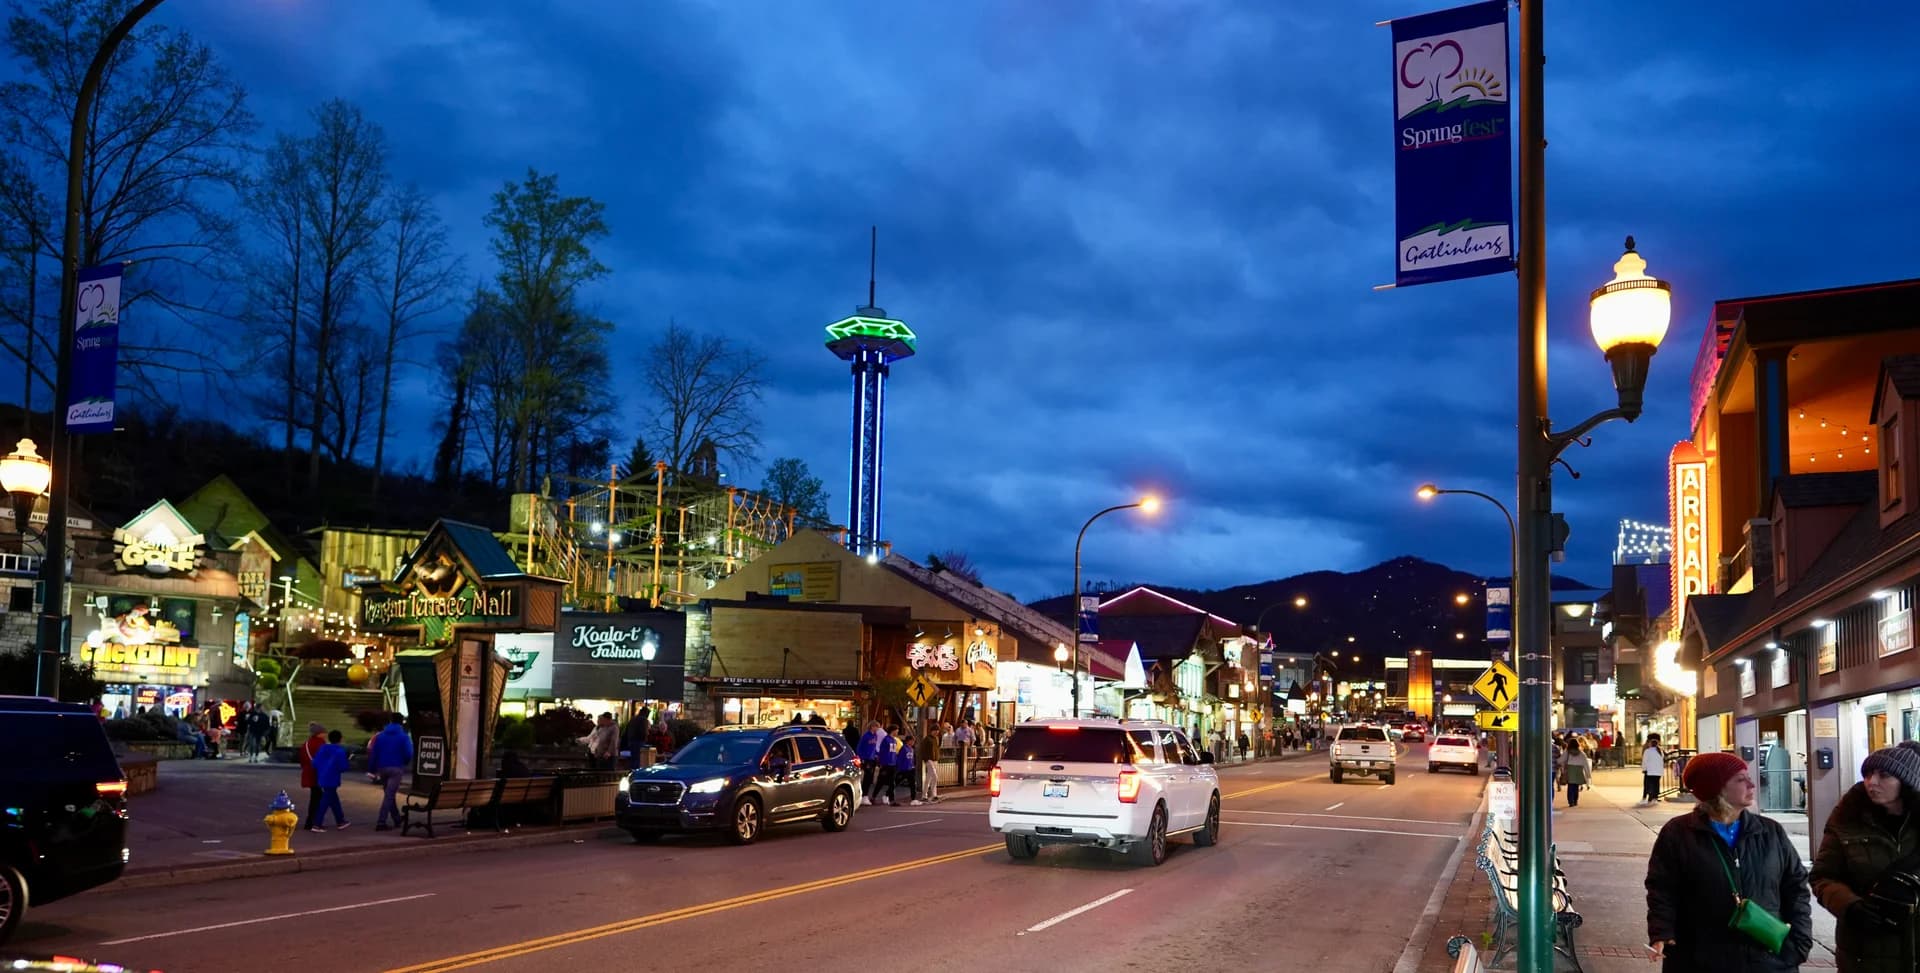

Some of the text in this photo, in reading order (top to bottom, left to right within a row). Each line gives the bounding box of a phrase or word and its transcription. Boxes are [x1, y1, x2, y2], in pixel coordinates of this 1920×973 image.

[1405, 236, 1502, 264] Gatlinburg
[70, 407, 112, 421] Gatlinburg
[1683, 470, 1701, 595] ARCAD
[122, 544, 195, 571] GOLF
[409, 590, 466, 618] Terrace
[473, 589, 513, 617] Mall
[572, 625, 641, 649] Koala-t
[164, 646, 200, 668] HUT
[591, 643, 641, 660] Fashion
[906, 643, 956, 659] ESCAPE
[911, 655, 959, 671] GAMES
[422, 741, 441, 750] MINI
[420, 751, 441, 760] GOLF
